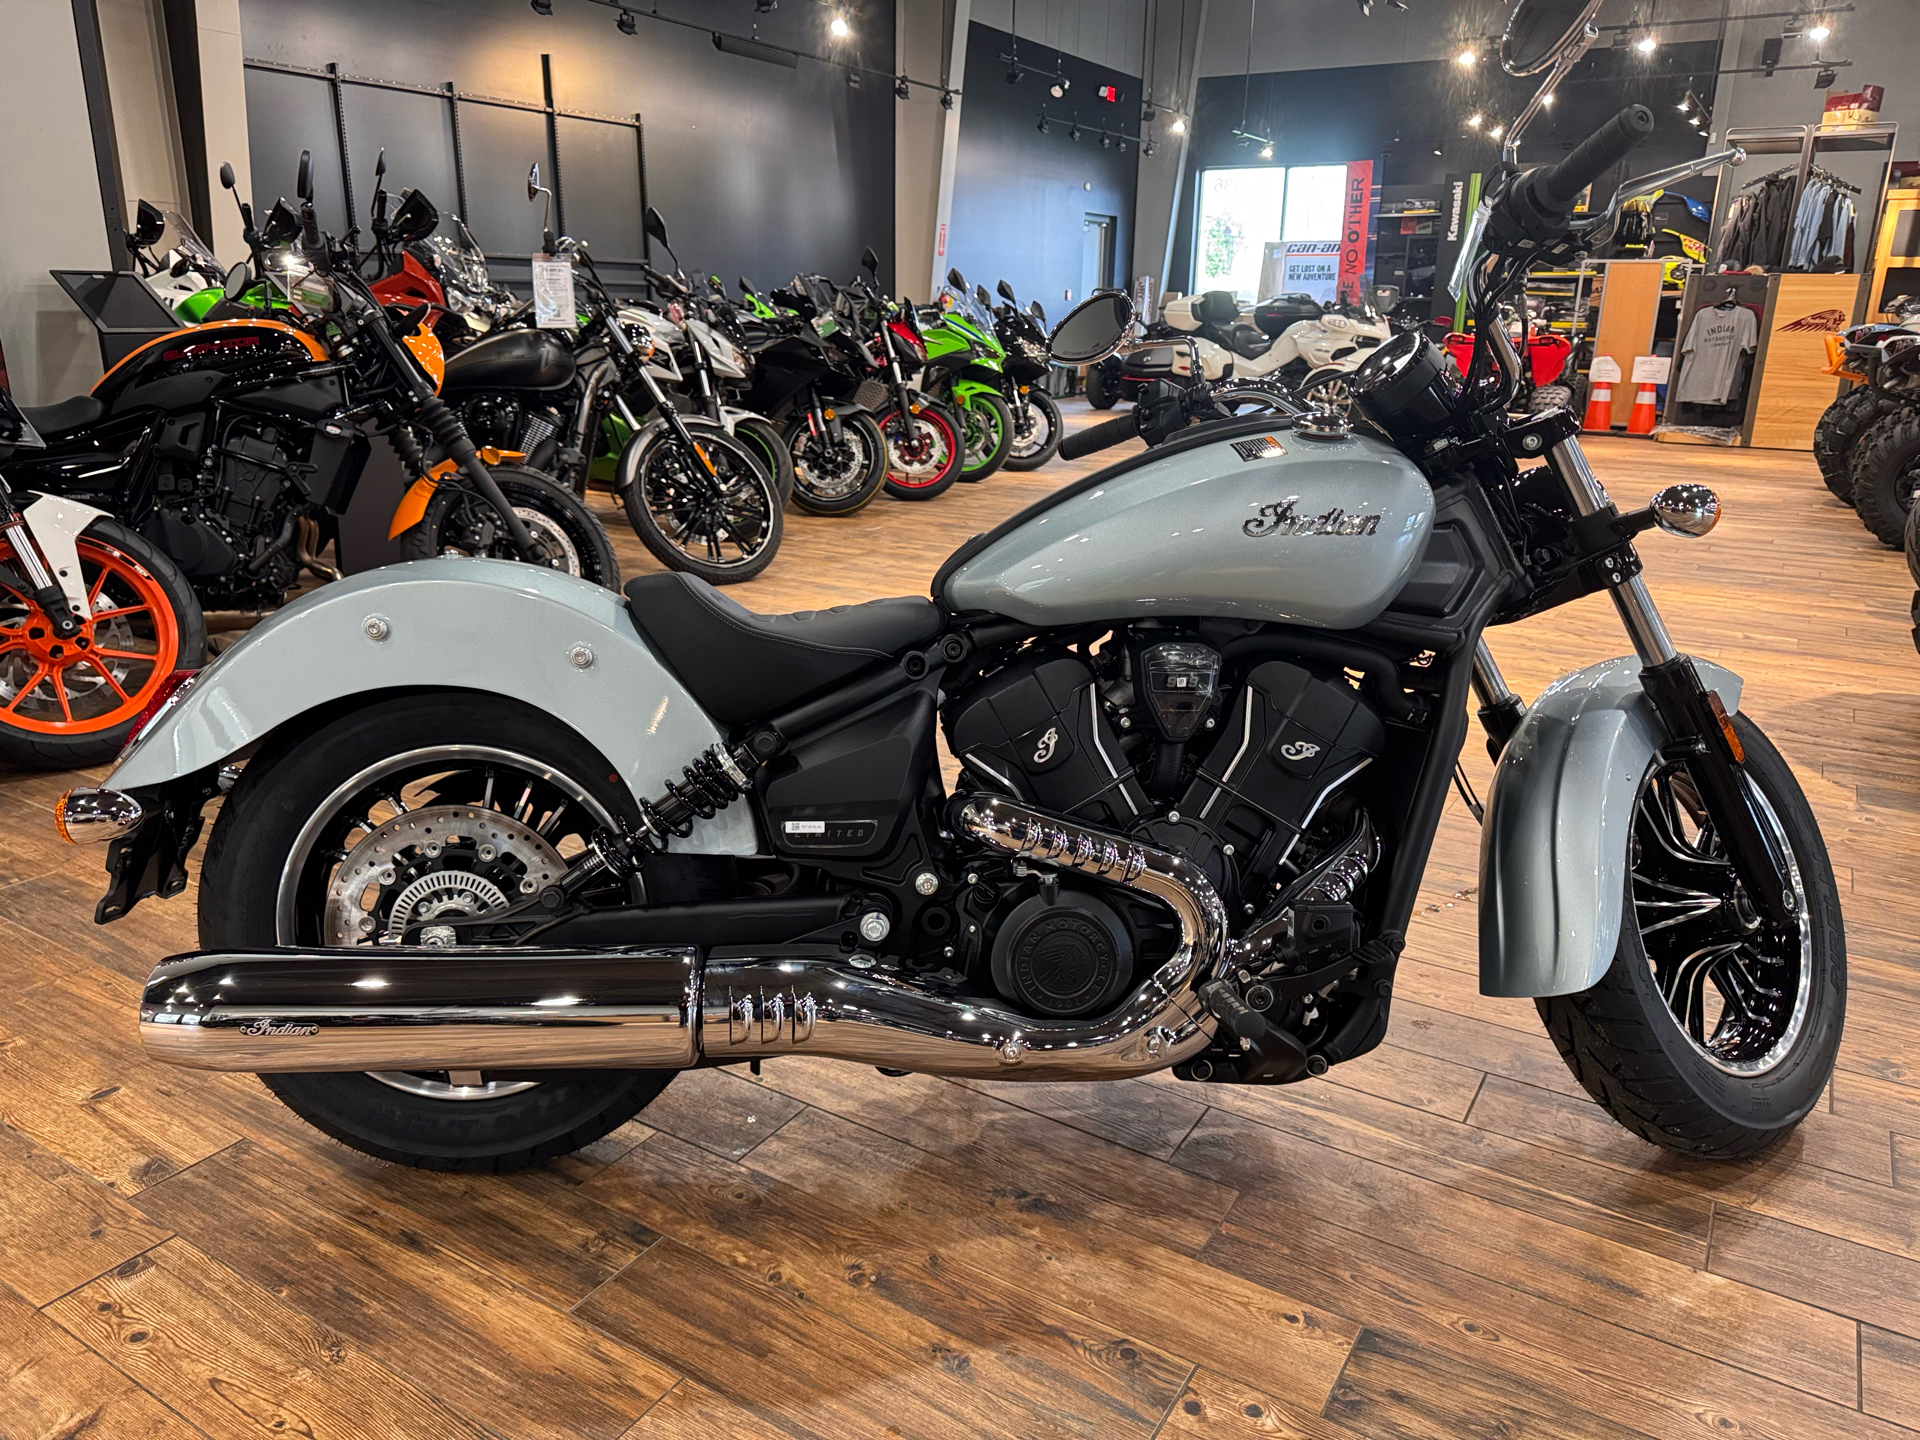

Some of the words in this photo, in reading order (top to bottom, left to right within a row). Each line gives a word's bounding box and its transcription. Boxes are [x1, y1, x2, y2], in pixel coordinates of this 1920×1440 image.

[1347, 177, 1364, 244] OTHER
[1446, 181, 1463, 241] Kawasaki
[1289, 264, 1300, 272] GET
[1301, 264, 1315, 272] LOST
[1316, 264, 1325, 272] ON
[1326, 264, 1332, 272] A
[1344, 248, 1358, 274] NO
[1288, 272, 1301, 281] NEW
[1302, 272, 1337, 281] ADVENTURE
[1706, 324, 1735, 336] INDIAN
[1242, 498, 1382, 537] Indian
[1166, 676, 1199, 688] 99
[794, 829, 864, 838] LIMITED
[1020, 932, 1041, 992] INDIAN
[1044, 918, 1109, 992] MOTORCYCLE
[246, 1018, 312, 1037] Indian
